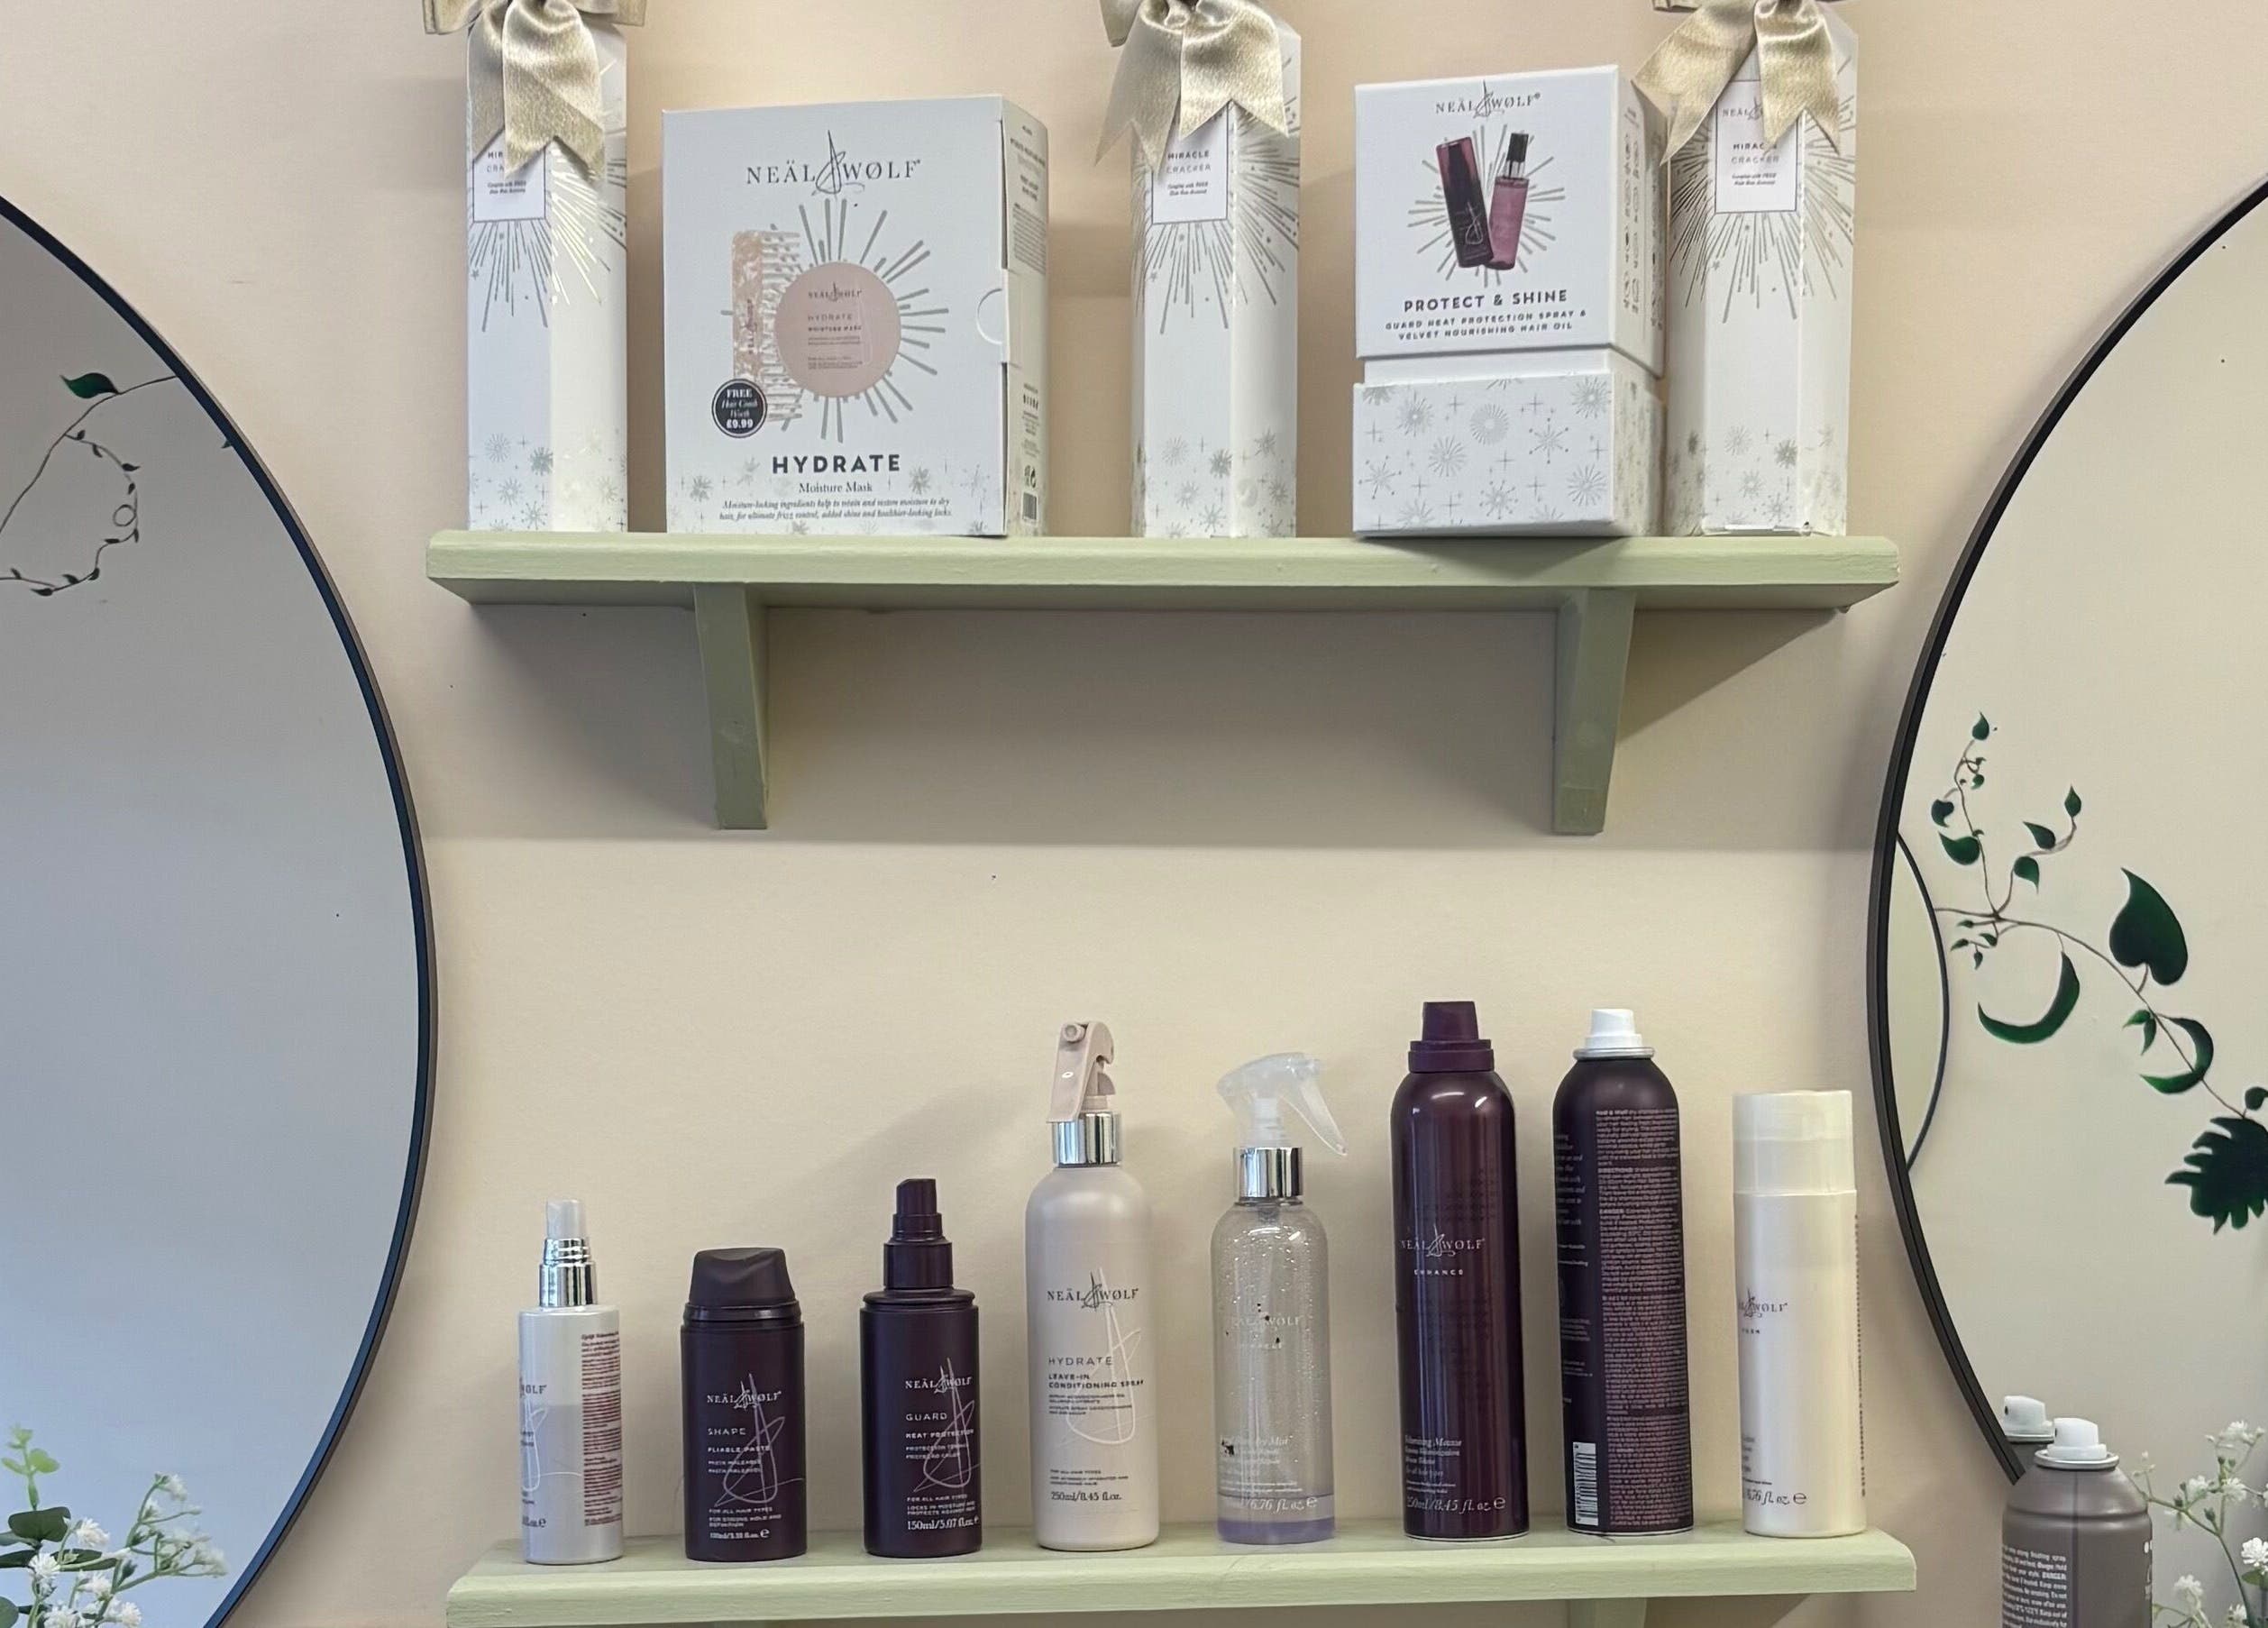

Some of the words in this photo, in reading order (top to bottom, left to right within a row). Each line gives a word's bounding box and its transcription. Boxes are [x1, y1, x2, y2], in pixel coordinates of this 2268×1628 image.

[1167, 150, 1210, 160] MIRACLE
[747, 160, 816, 185] NEÄL
[1404, 295, 1486, 313] PROTECT
[1493, 294, 1504, 306] &
[1512, 289, 1568, 305] SHINE
[1385, 320, 1423, 331] GUARD
[1427, 317, 1456, 327] HEAT
[1460, 312, 1533, 325] PROTECTION
[1539, 310, 1575, 320] SPRAY
[1398, 330, 1440, 341] VELVET
[1444, 325, 1515, 337] NOURISHING
[1520, 324, 1549, 333] HAIR
[1552, 321, 1573, 331] OIL
[727, 389, 753, 398] FREE
[726, 418, 754, 429] £9.99
[773, 453, 901, 474] HYDRATE
[799, 481, 843, 494] Moisture
[846, 480, 873, 493] Mask
[1048, 1356, 1113, 1367] HYDRATE
[1048, 1373, 1090, 1381] LEAVE-IN
[1048, 1381, 1118, 1389] CONDITIONING
[905, 1412, 947, 1422] GUARD
[708, 1427, 746, 1436] SHAPE
[1493, 1496, 1506, 1510] e
[1793, 1492, 1807, 1505] e
[760, 1529, 770, 1539] e
